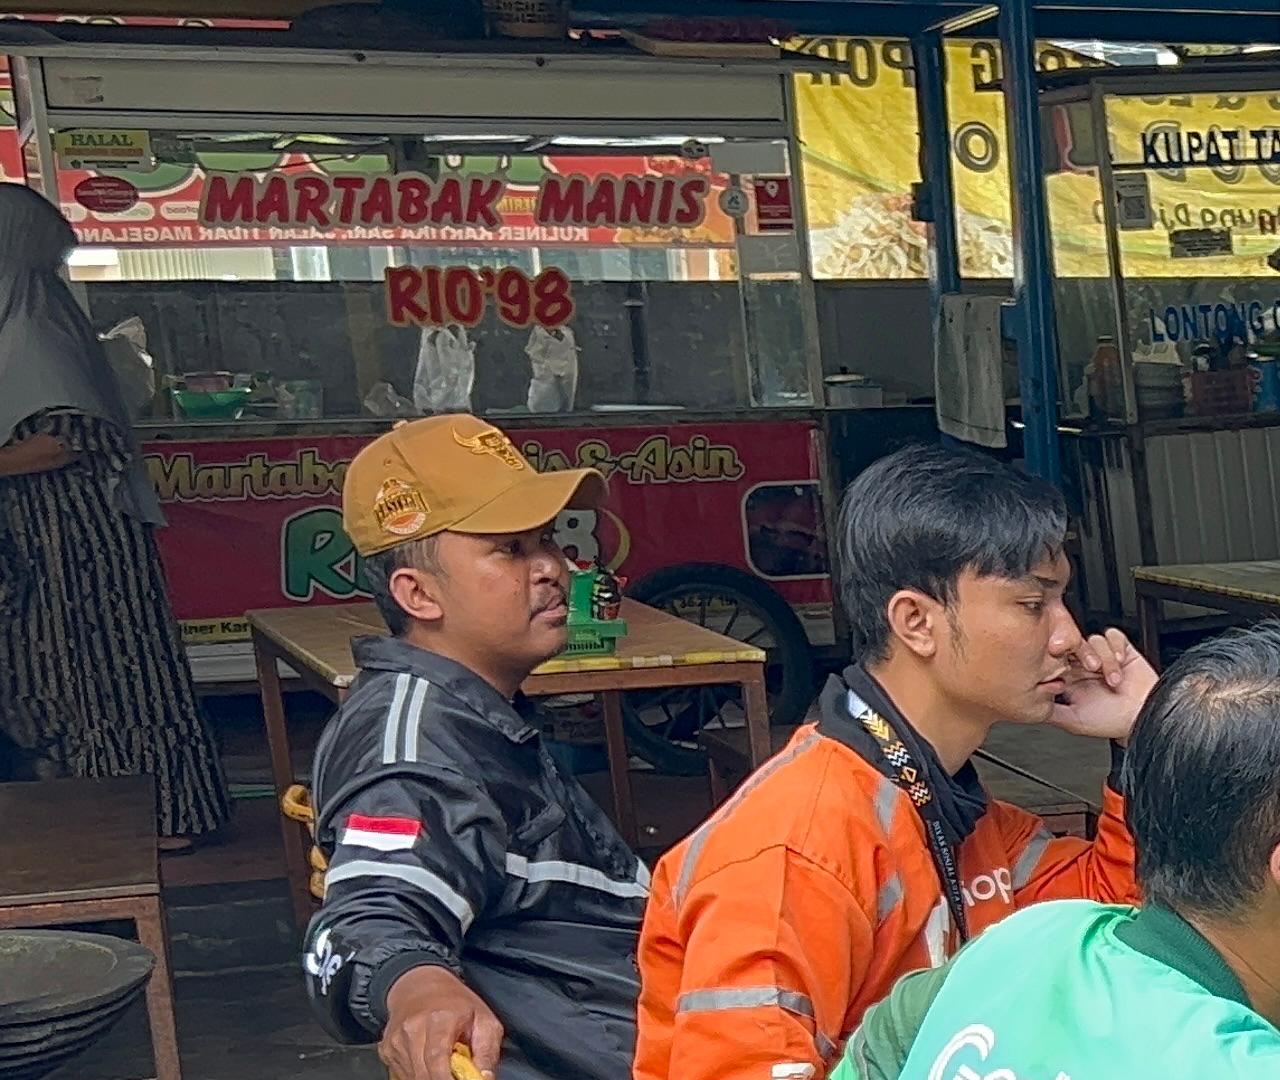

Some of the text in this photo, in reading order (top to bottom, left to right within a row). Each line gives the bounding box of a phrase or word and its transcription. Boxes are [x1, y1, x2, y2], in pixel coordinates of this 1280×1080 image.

[70, 132, 133, 147] HALAL
[1141, 129, 1239, 164] KUPAT
[201, 173, 504, 229] MARTABAK
[535, 174, 708, 228] MANIS
[385, 266, 575, 329] RIO'98
[1149, 302, 1266, 345] LONTONG
[145, 443, 352, 501] Martaba
